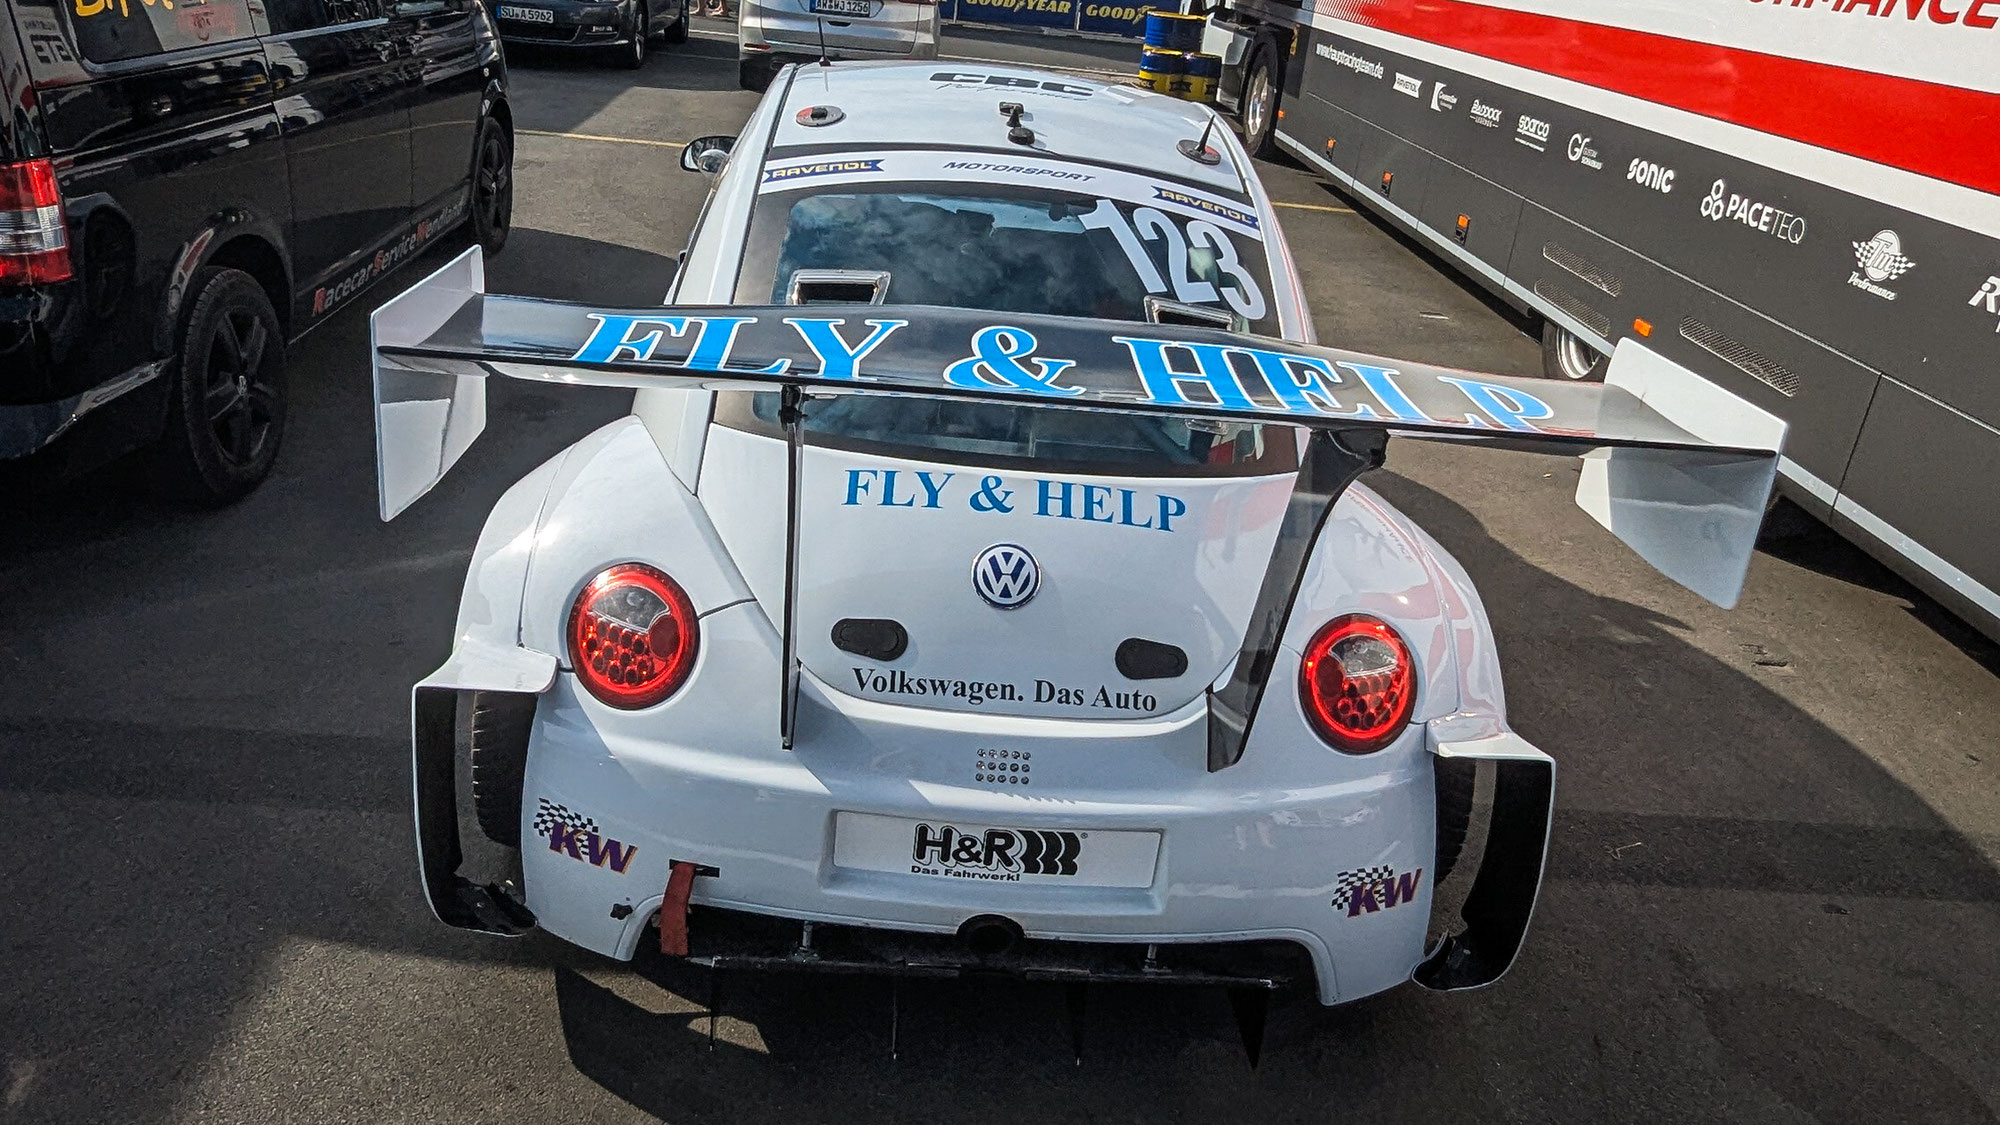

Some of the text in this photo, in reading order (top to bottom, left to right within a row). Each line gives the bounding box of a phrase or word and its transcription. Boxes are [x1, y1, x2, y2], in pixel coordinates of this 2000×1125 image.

[772, 161, 873, 179] RAVENOL
[943, 161, 1097, 183] MOTORSPORT
[1161, 190, 1253, 224] RAVENOL
[1726, 193, 1806, 245] PACETEQ
[1078, 199, 1266, 320] 123
[570, 314, 1555, 432] FLY & HELP
[841, 469, 1186, 532] FLY & HELP
[852, 667, 1158, 713] Volkswagen. Das Auto
[549, 818, 638, 874] KW
[913, 824, 1018, 870] H&R
[911, 865, 939, 876] Das
[1346, 868, 1423, 918] KW
